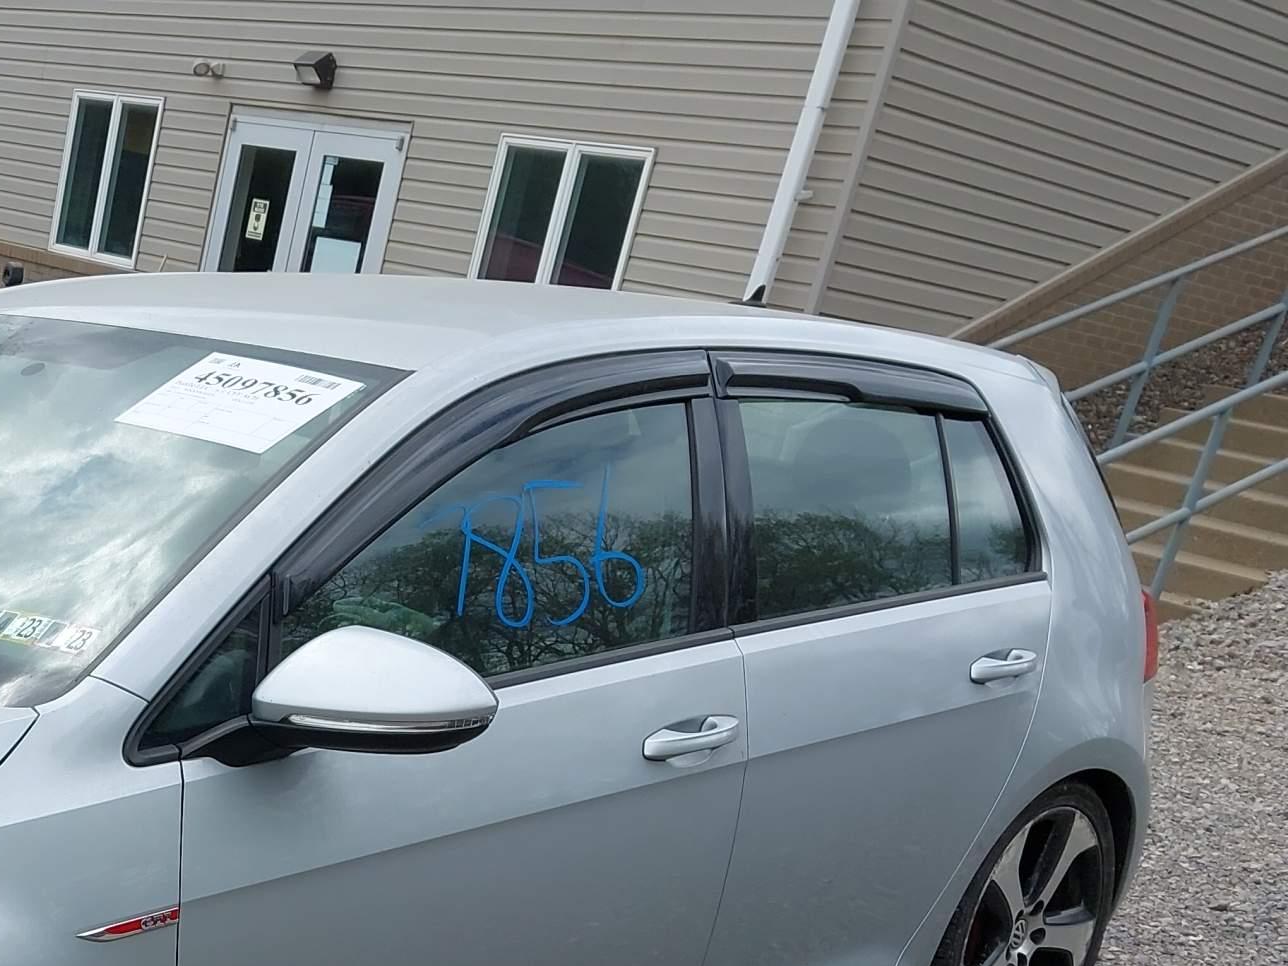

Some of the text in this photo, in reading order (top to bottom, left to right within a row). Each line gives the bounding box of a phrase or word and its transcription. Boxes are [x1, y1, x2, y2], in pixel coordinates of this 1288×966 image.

[194, 370, 321, 406] 45097856
[16, 618, 43, 639] 23
[65, 629, 93, 651] 23
